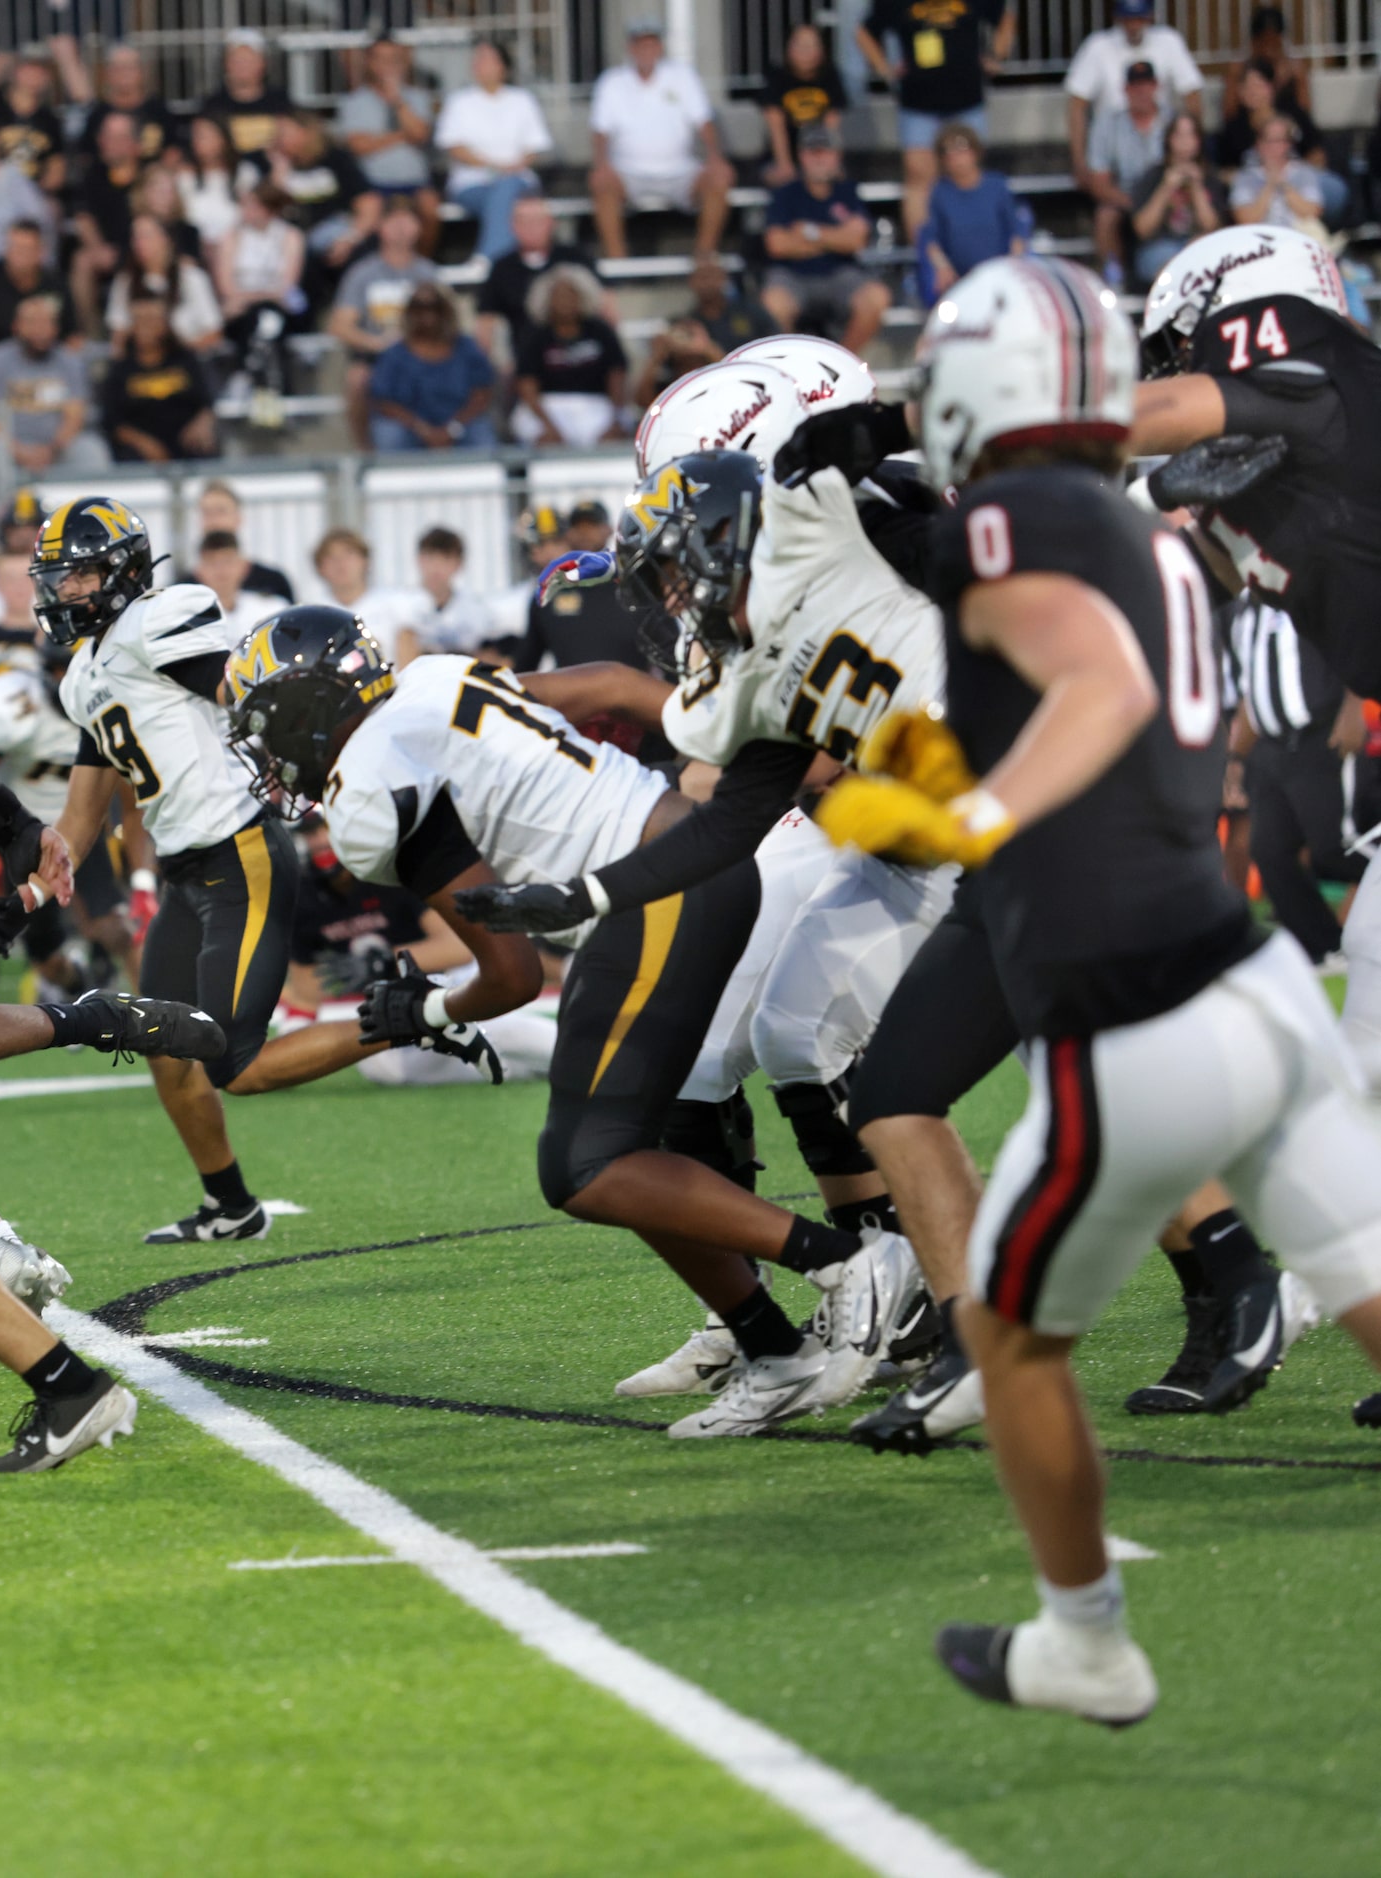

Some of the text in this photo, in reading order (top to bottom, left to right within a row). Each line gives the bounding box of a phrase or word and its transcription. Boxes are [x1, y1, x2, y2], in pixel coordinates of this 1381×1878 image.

[1219, 305, 1289, 374] 74
[966, 503, 1014, 579] 0
[226, 617, 289, 712] M
[1152, 529, 1220, 749] 0
